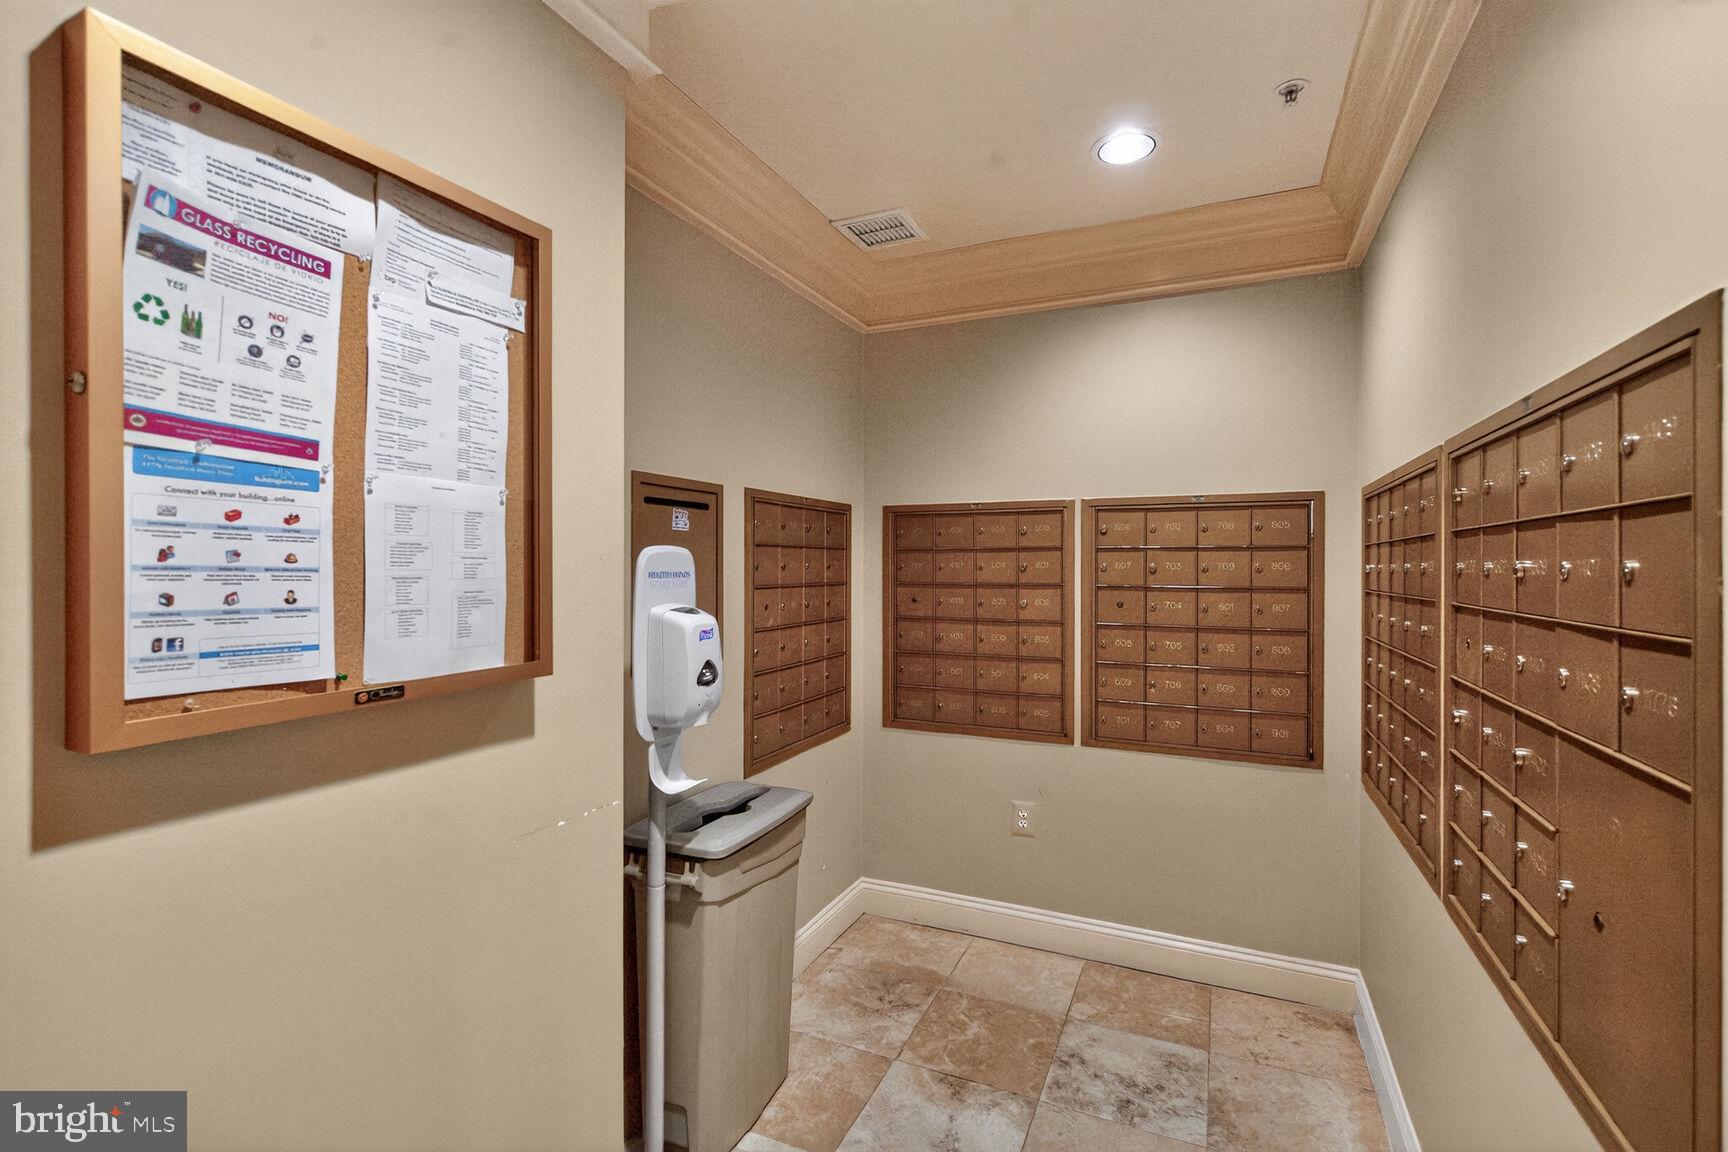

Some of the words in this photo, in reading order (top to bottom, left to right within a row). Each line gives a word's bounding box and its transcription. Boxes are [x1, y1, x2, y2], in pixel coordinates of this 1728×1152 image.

[181, 207, 232, 239] GLASS
[237, 229, 326, 273] RECYCLING
[165, 277, 187, 292] YES!
[268, 311, 288, 325] NO!
[164, 485, 200, 496] Connect
[200, 487, 216, 498] with
[219, 489, 236, 500] your
[1217, 562, 1235, 571] 709
[1271, 729, 1289, 738] 901
